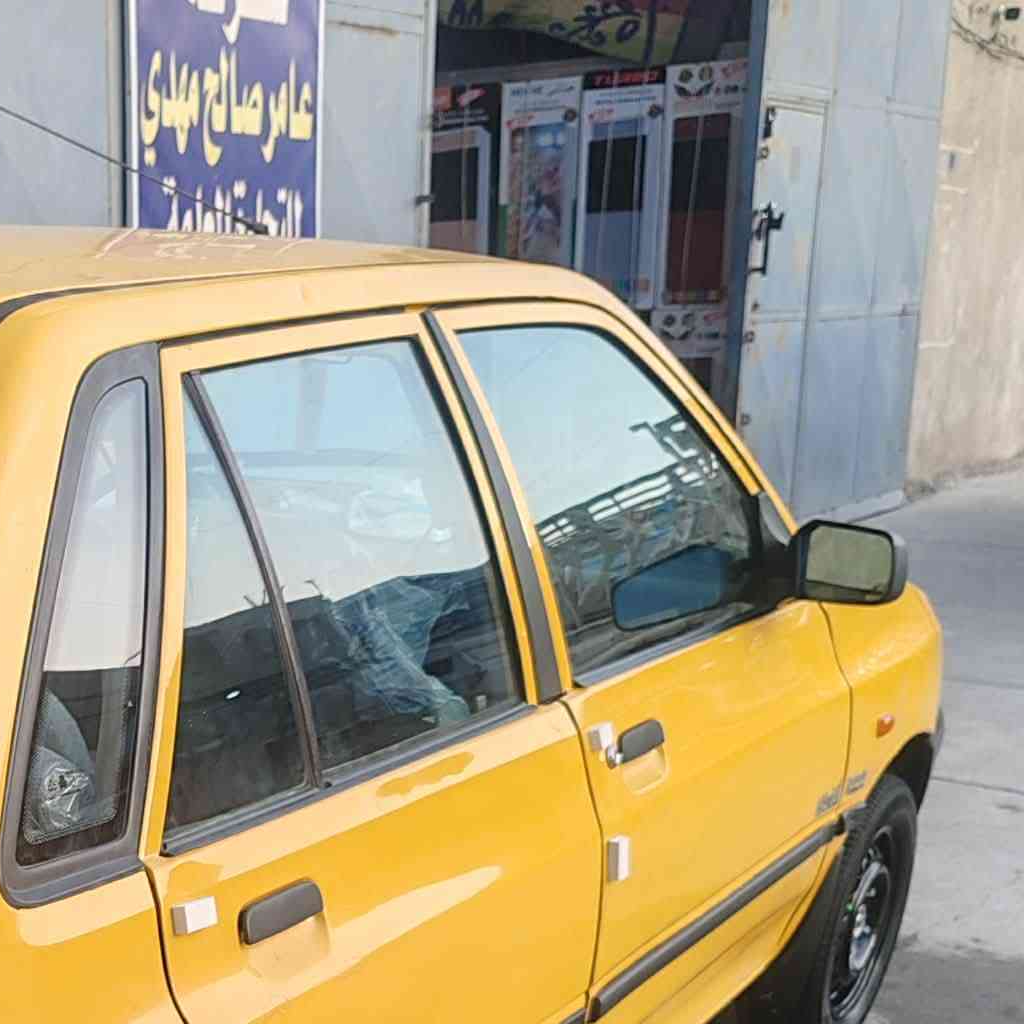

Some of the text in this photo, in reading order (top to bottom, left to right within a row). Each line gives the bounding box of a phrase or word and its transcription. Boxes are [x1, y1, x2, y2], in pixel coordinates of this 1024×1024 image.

[141, 46, 314, 168] عامر صالح مهدي
